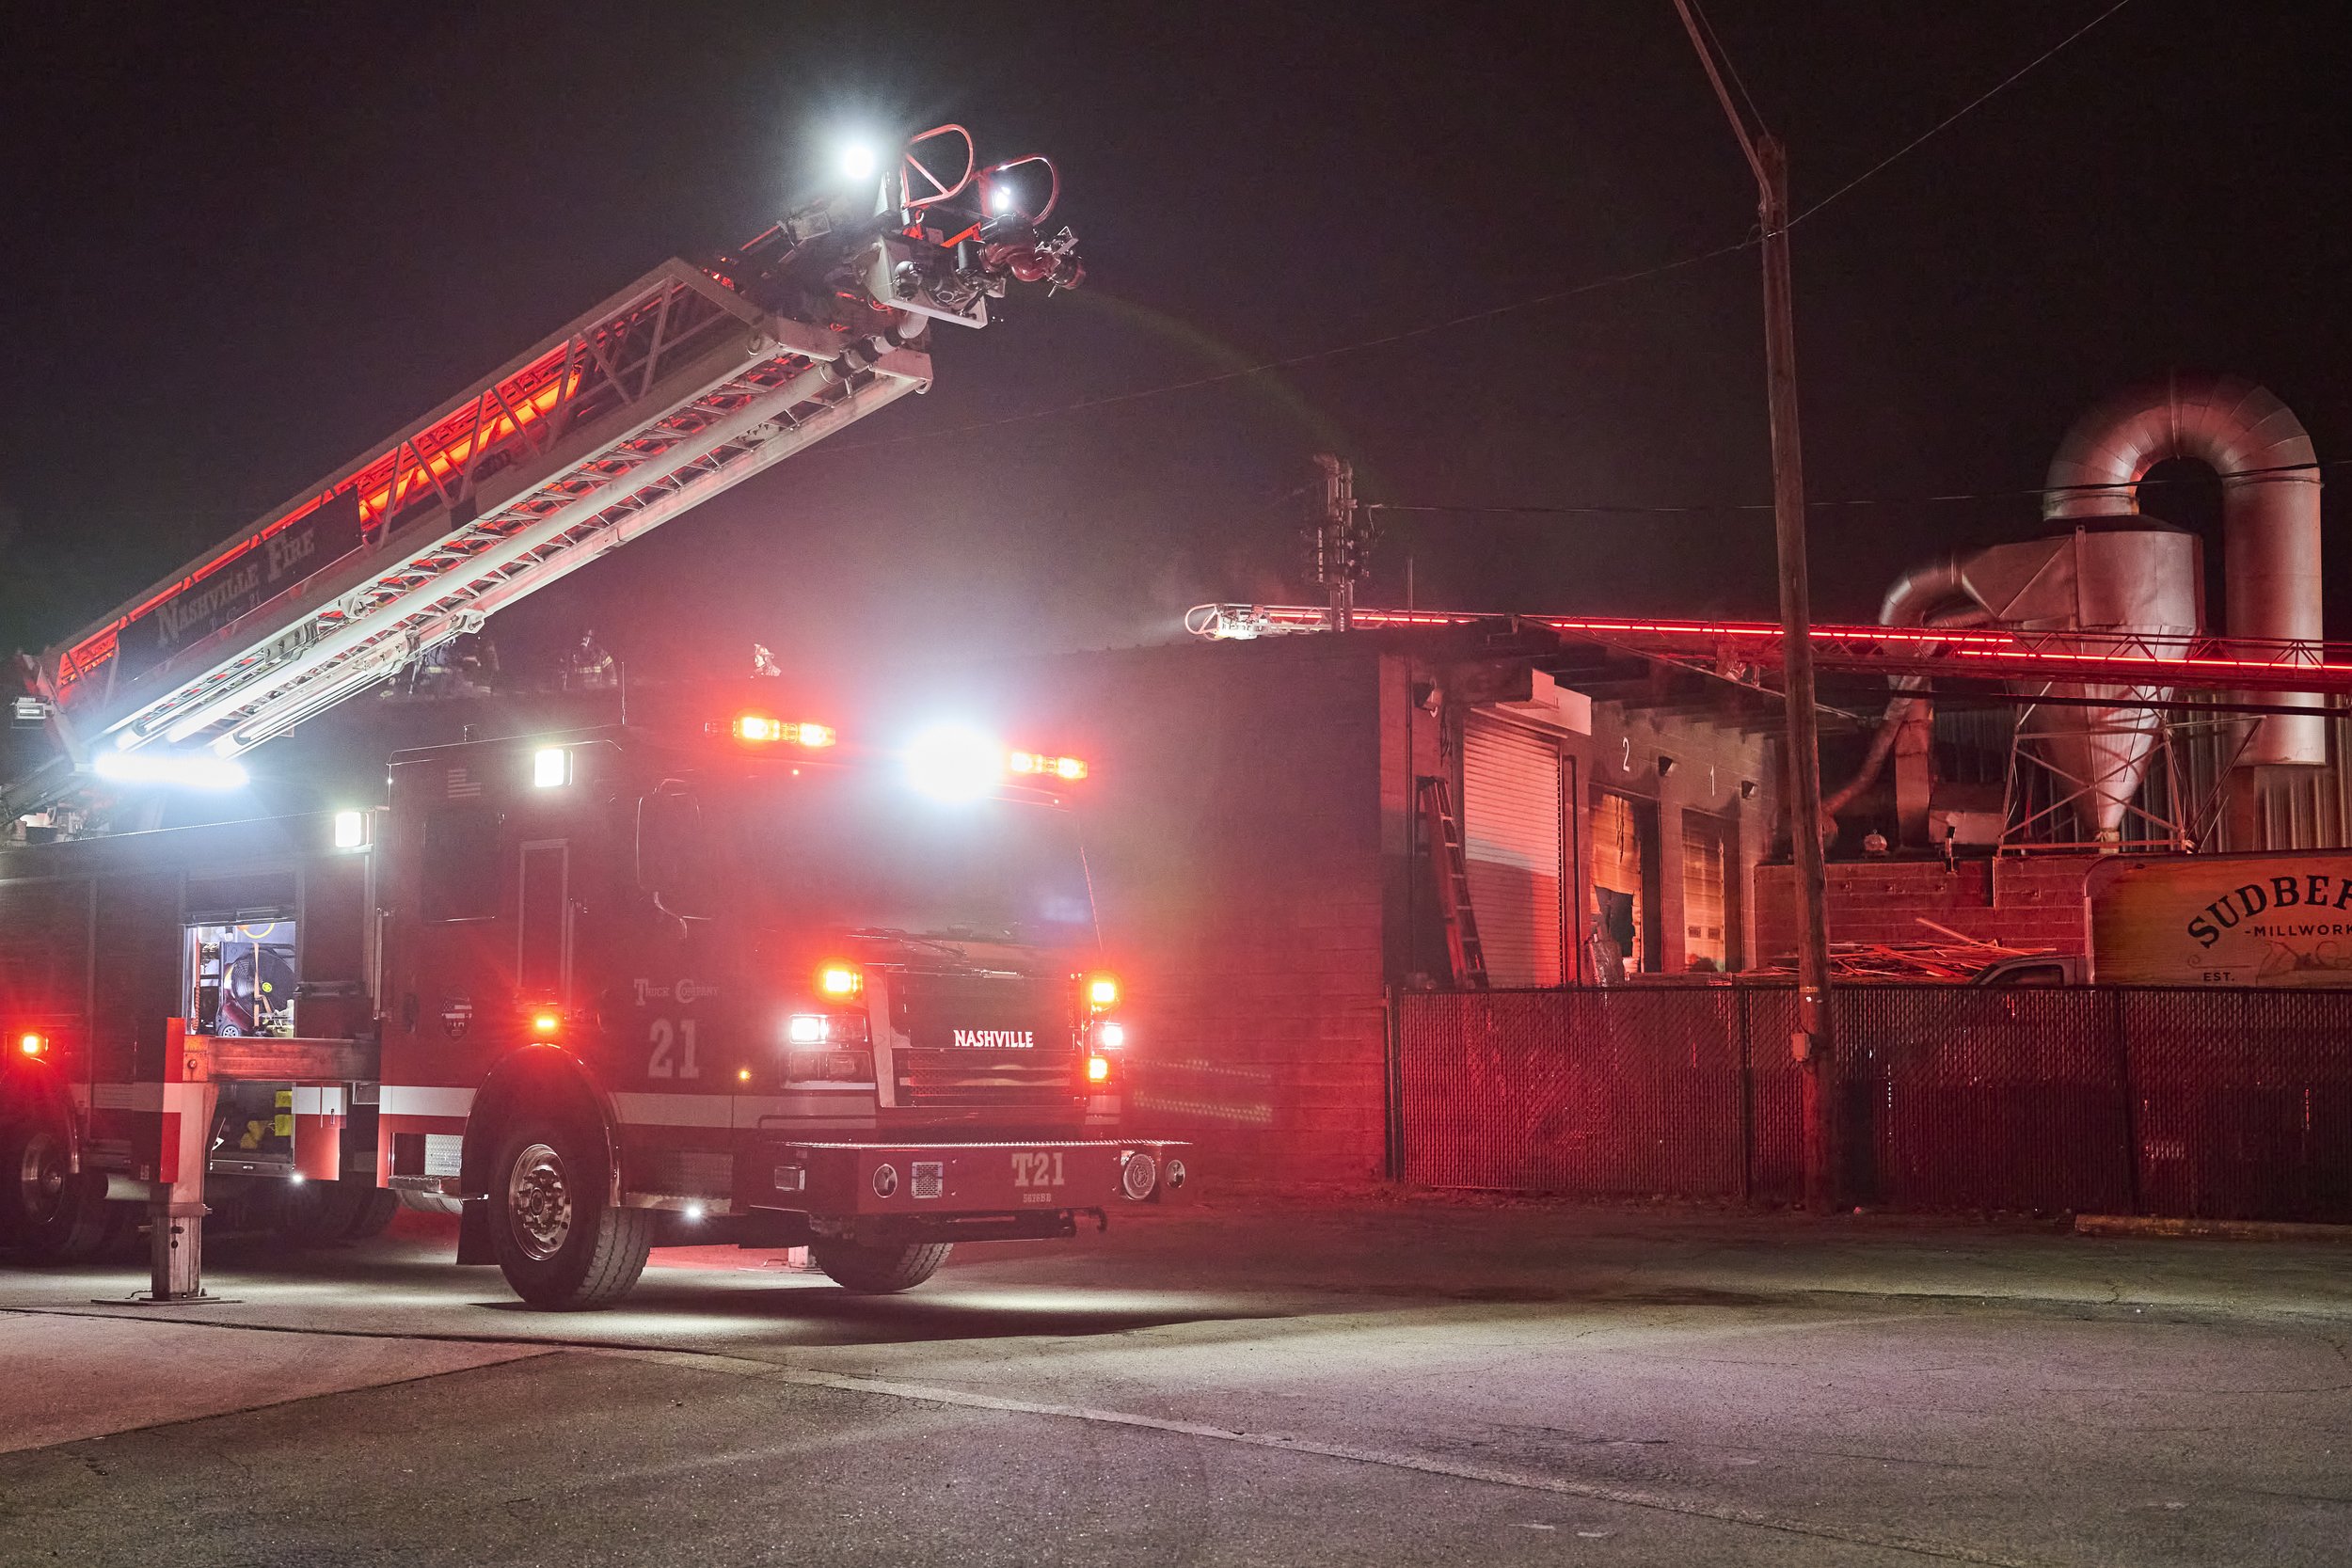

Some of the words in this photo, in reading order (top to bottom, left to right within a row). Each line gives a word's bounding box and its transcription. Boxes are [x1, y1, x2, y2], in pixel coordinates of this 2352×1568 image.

[266, 528, 315, 583] FIRE
[1622, 736, 1630, 772] 2
[1709, 765, 1715, 797] 1
[2203, 972, 2235, 982] EST.
[647, 1018, 700, 1079] 21
[953, 1029, 1034, 1048] NASHVILLE
[1011, 1151, 1065, 1187] T21
